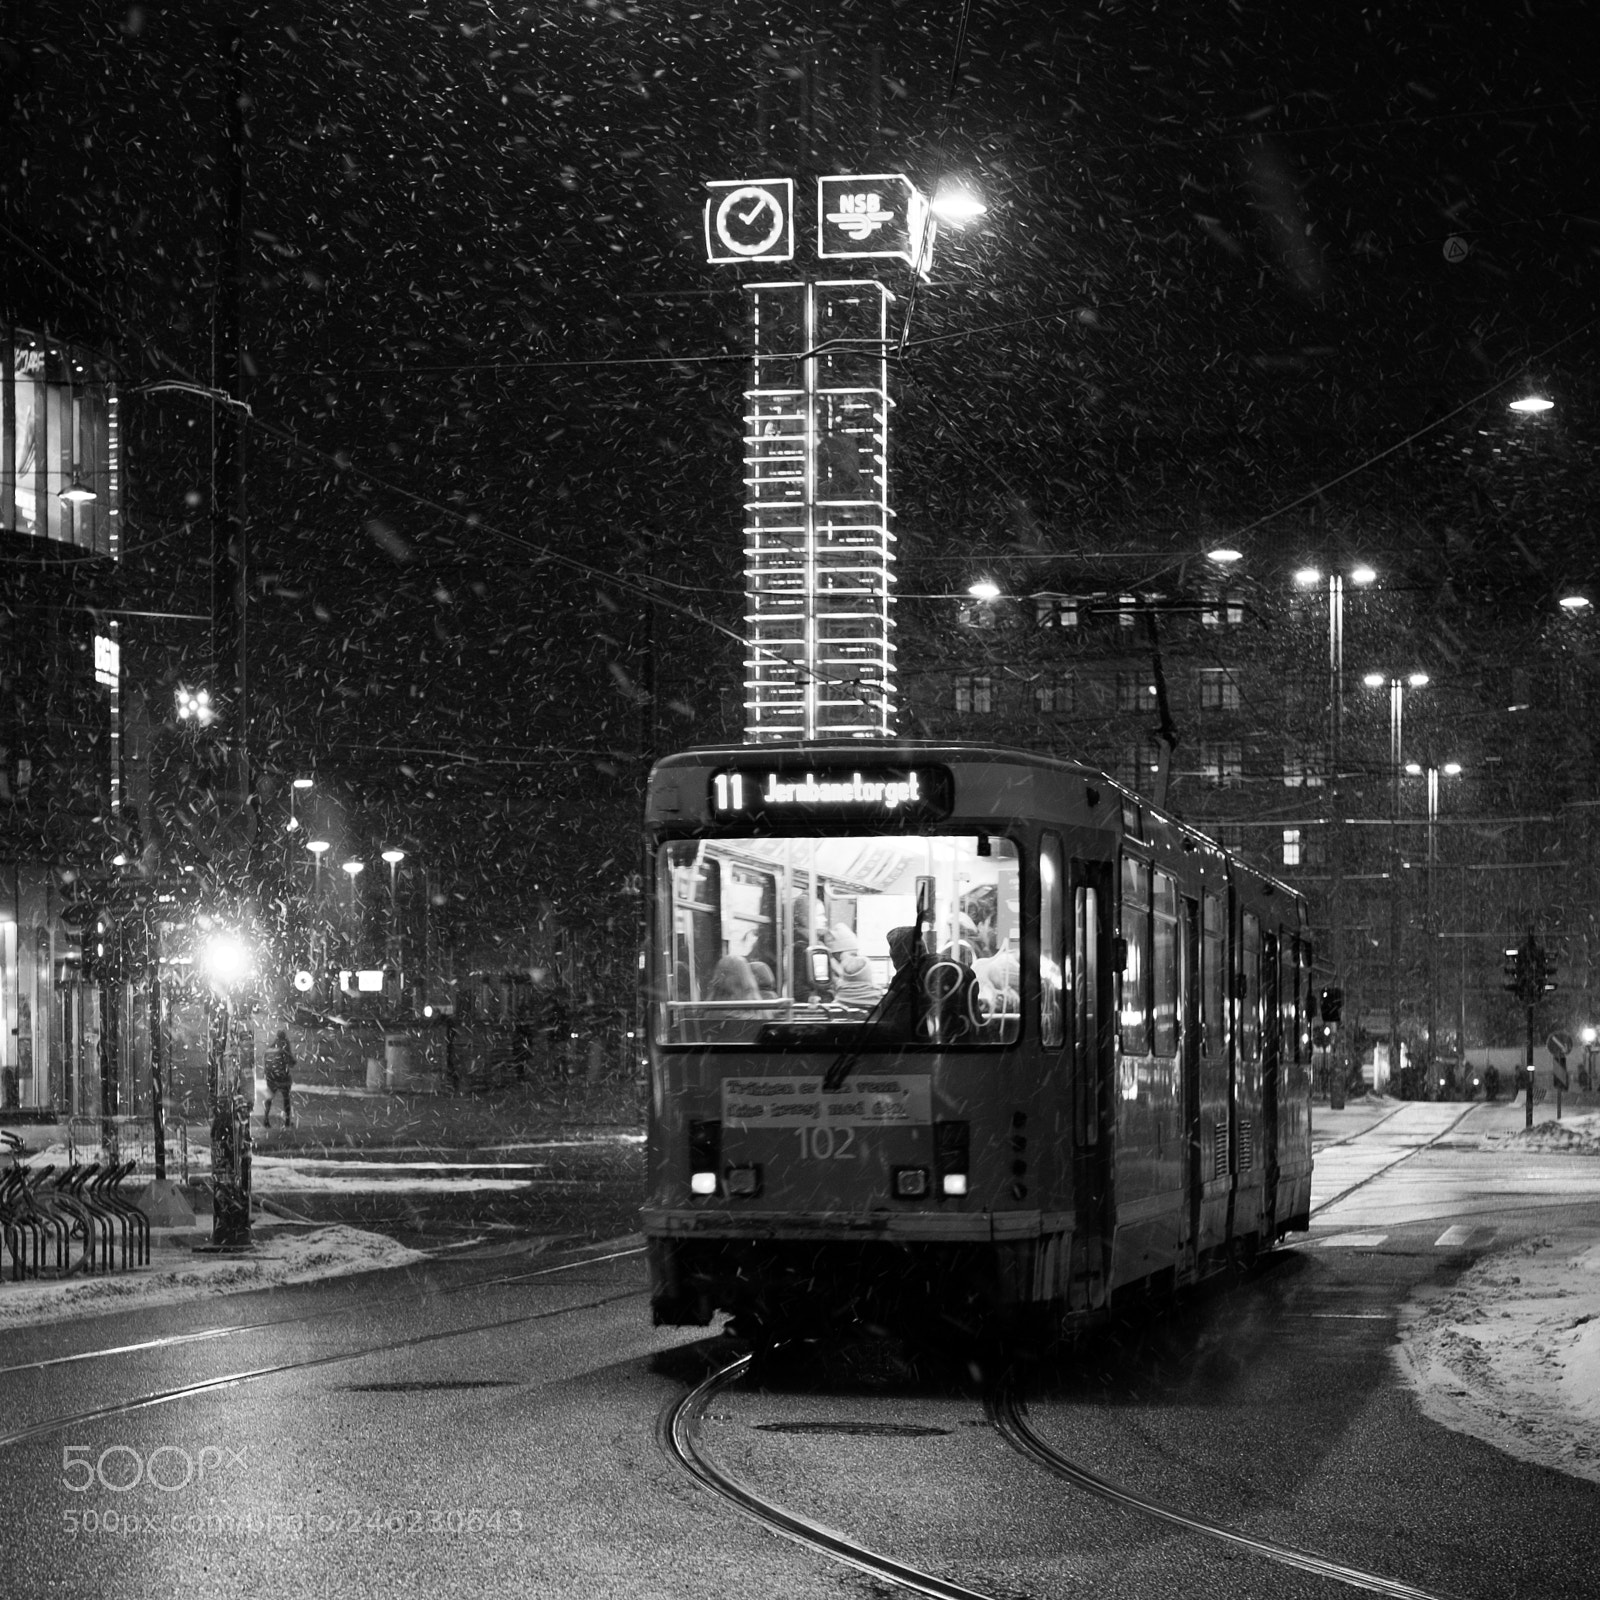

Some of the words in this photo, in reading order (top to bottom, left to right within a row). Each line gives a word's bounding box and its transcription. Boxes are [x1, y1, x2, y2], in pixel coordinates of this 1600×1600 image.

[839, 193, 881, 213] NSB
[714, 774, 743, 809] 11
[764, 772, 920, 808] Jernbanetorget
[794, 1126, 857, 1160] 102
